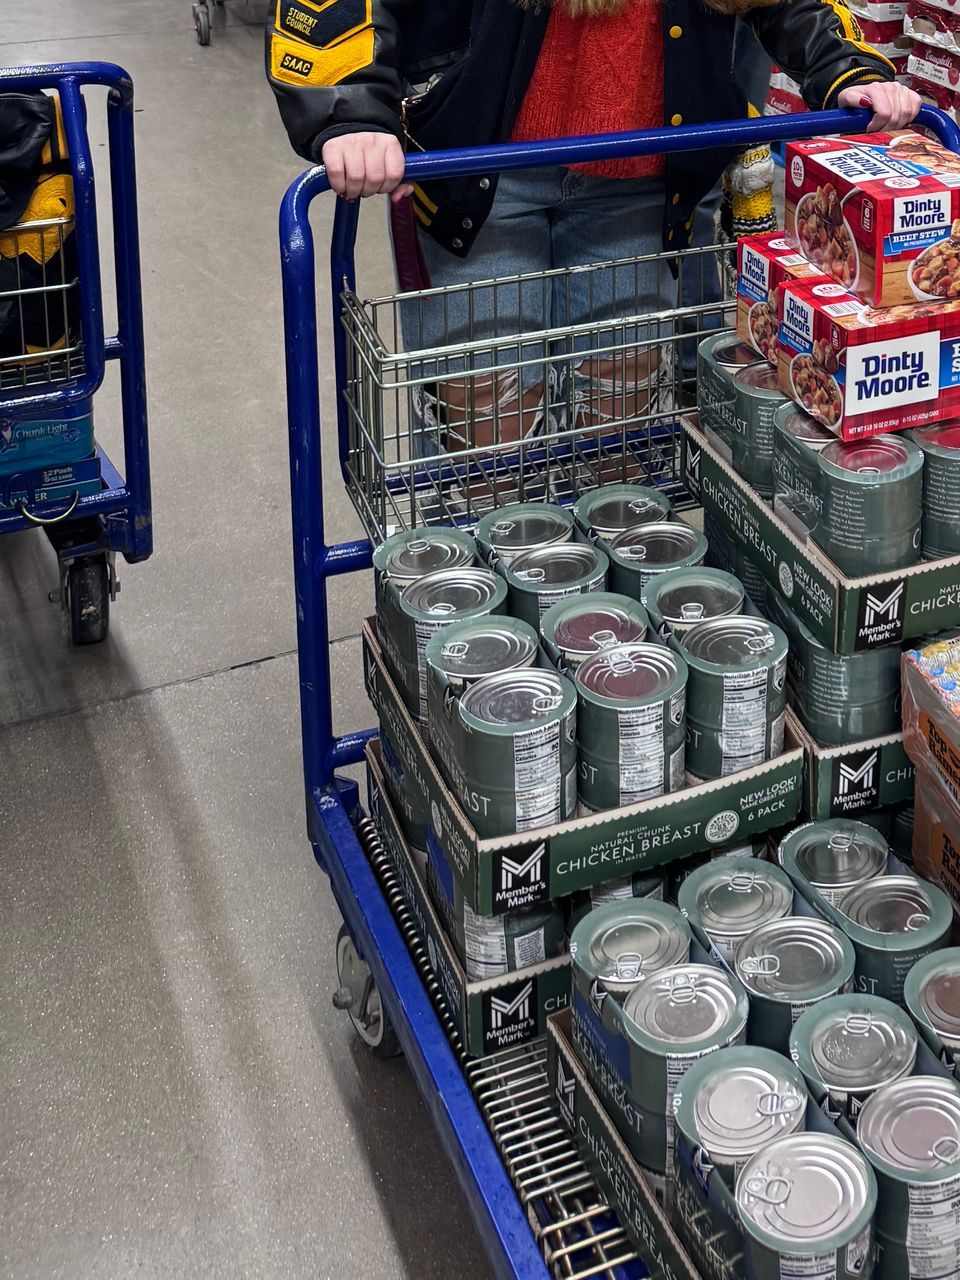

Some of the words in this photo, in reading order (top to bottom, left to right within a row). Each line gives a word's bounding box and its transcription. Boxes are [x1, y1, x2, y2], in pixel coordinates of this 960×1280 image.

[285, 16, 311, 36] COUNCIL
[288, 7, 318, 28] STUDENT
[283, 55, 311, 73] SAAC
[925, 49, 953, 69] Campbell's
[903, 199, 941, 215] Dinty
[899, 212, 946, 229] Moore
[892, 231, 918, 243] BEEF
[920, 228, 946, 239] STEW
[746, 250, 765, 272] Dinty
[744, 262, 767, 285] Moore
[788, 297, 809, 323] Dinty
[786, 309, 810, 336] Moore
[861, 351, 925, 378] Dinty
[854, 371, 930, 400] Moore
[15, 427, 46, 439] Chunk
[48, 423, 68, 435] Light
[702, 476, 741, 529] CHICKEN
[743, 521, 777, 567] BREAST
[859, 620, 902, 637] Member's
[867, 631, 891, 643] Mark
[927, 718, 948, 754] Top
[739, 788, 766, 805] NEW
[766, 775, 797, 796] LOOK!
[833, 787, 877, 805] Member's
[758, 799, 786, 817] PACK
[843, 798, 866, 811] Mark
[590, 835, 635, 853] NATURAL
[636, 824, 672, 841] CHUNK
[617, 825, 648, 837] PREMIUM
[556, 843, 636, 875] CHICKEN
[641, 822, 702, 852] BREAST
[624, 851, 647, 862] WATER
[495, 881, 547, 902] Member's
[507, 895, 534, 908] Mark
[486, 1018, 535, 1040] Member's
[498, 1031, 524, 1046] Mark
[578, 1116, 631, 1212] CHICKEN
